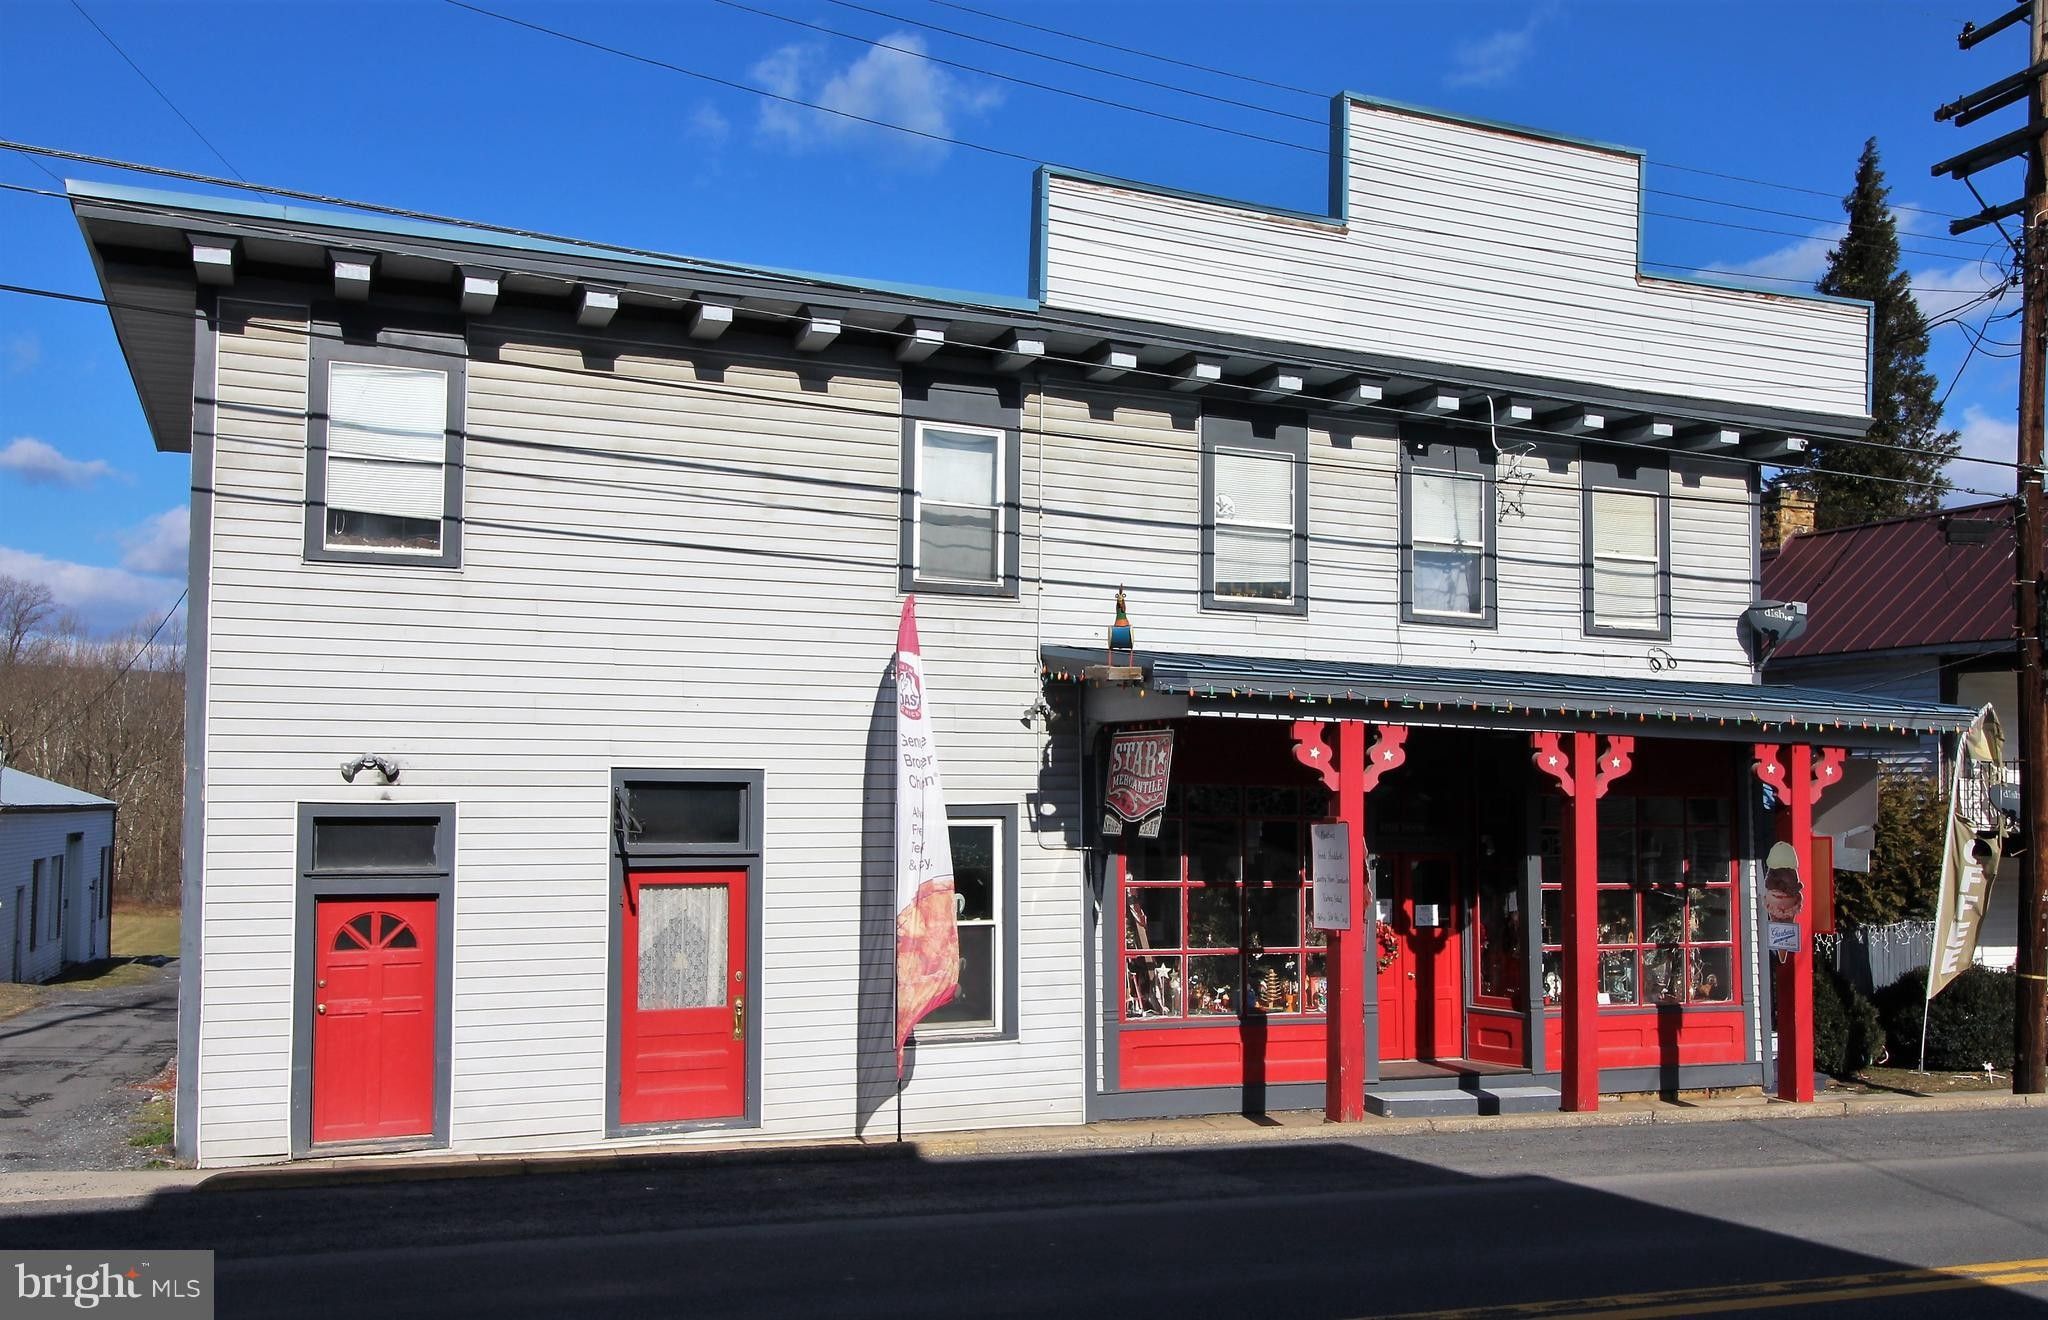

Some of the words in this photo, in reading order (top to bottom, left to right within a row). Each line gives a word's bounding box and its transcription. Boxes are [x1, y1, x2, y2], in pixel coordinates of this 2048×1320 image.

[1764, 608, 1785, 618] dish
[1112, 740, 1158, 778] STAR
[1112, 773, 1163, 794] MERCANTILE
